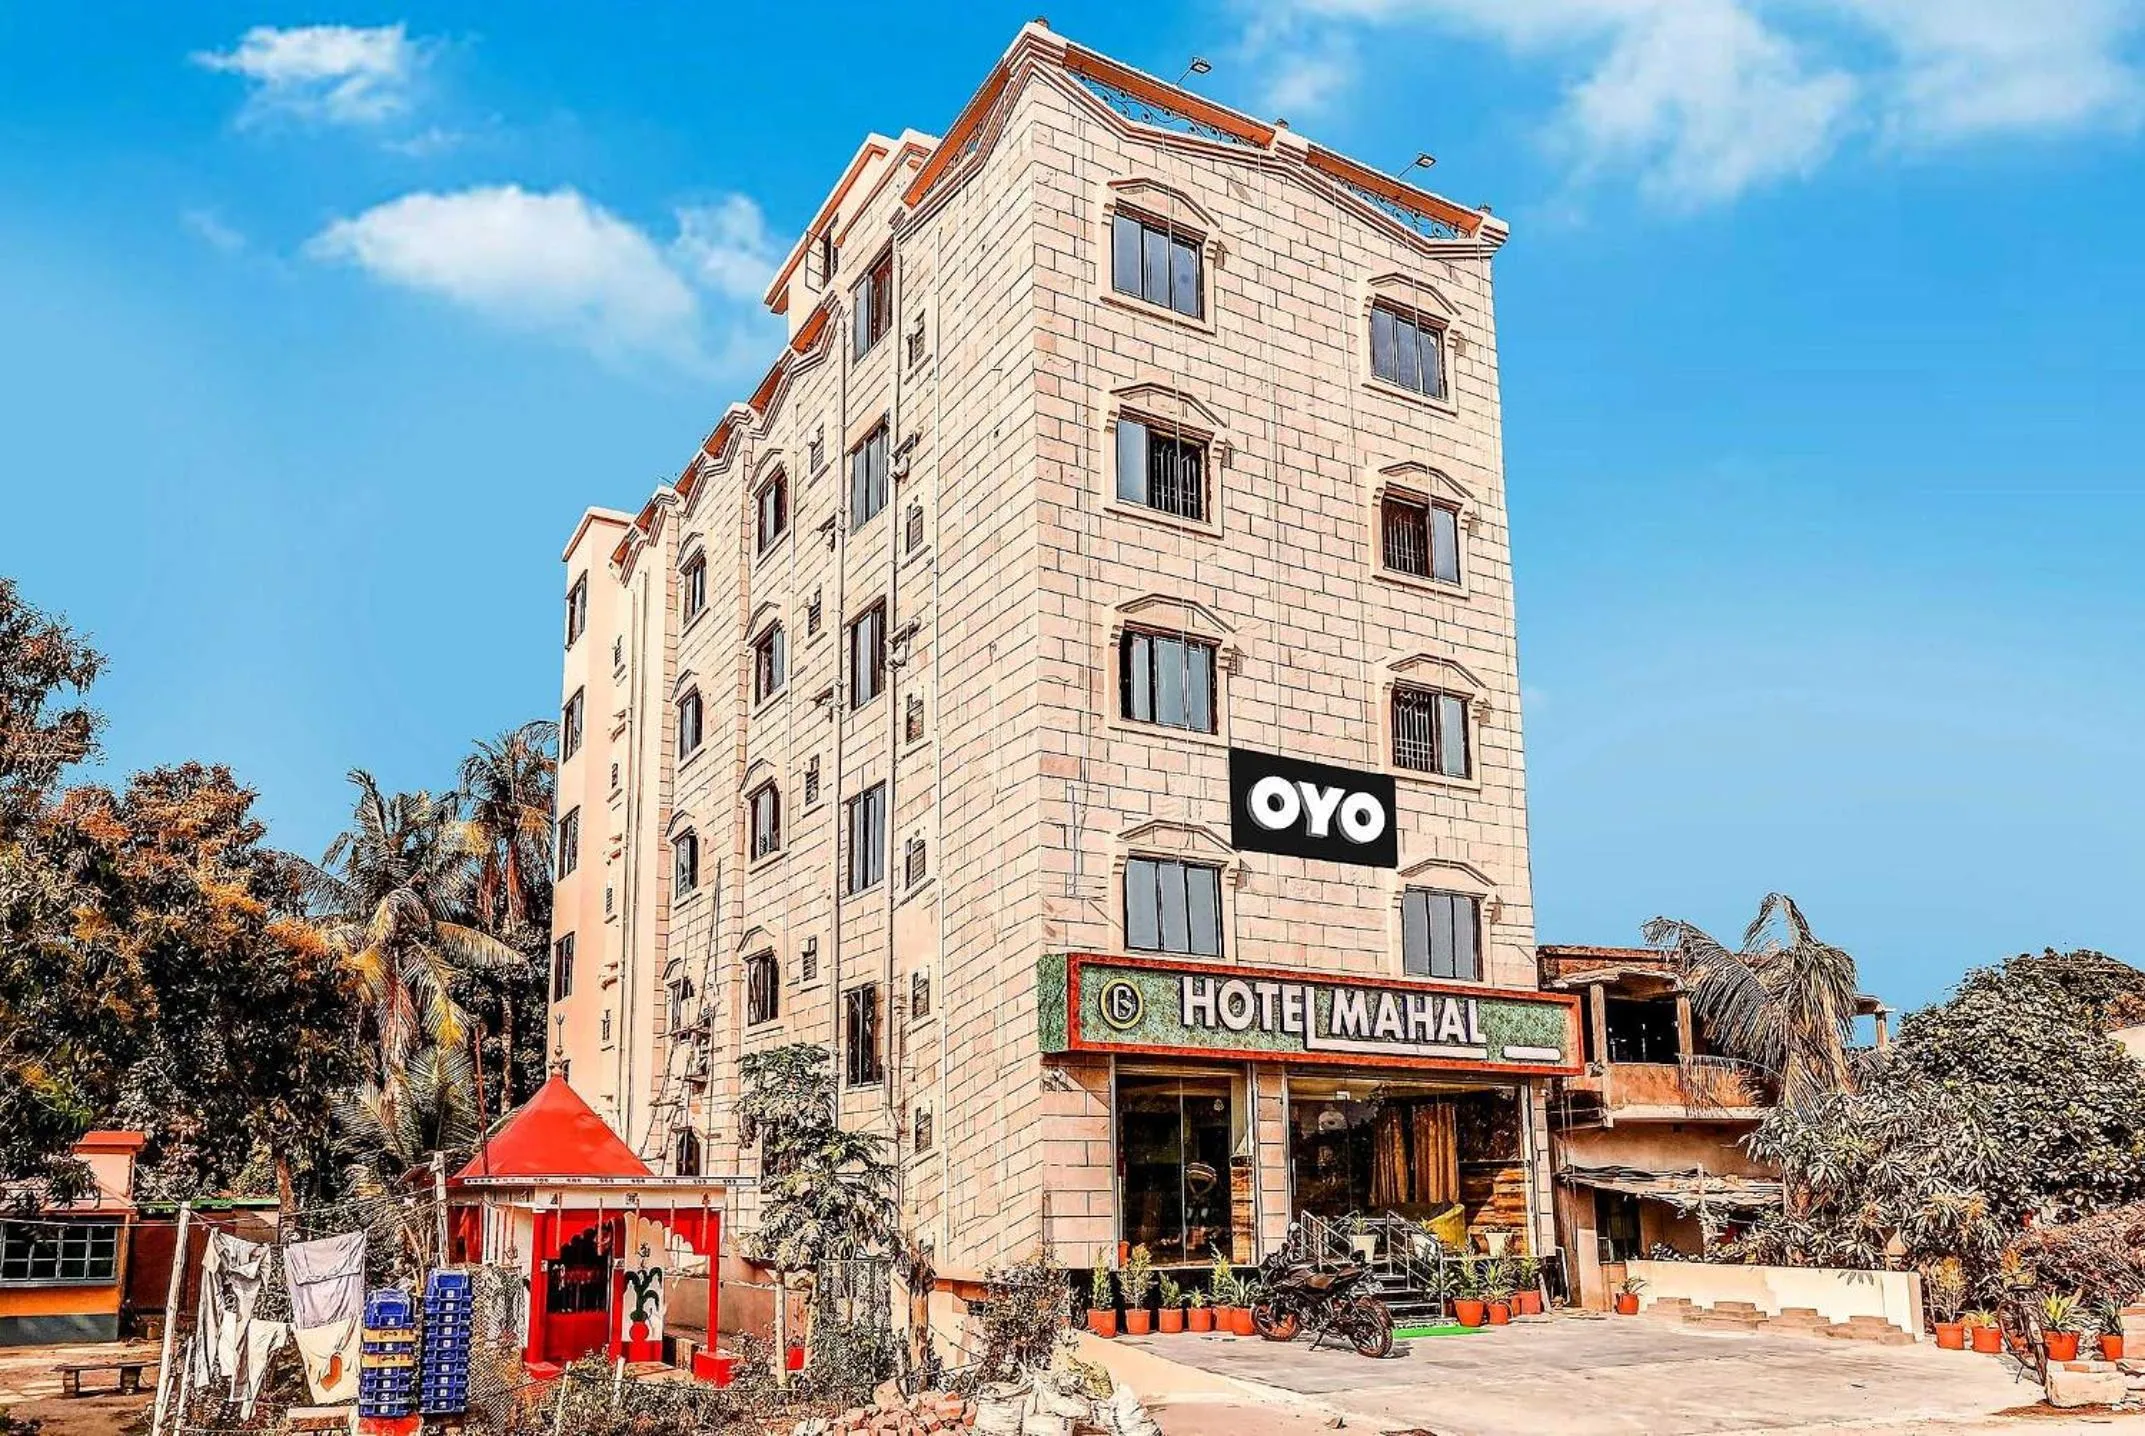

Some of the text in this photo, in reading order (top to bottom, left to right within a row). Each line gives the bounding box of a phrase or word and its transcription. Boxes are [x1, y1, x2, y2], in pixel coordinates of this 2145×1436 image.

[1247, 776, 1385, 844] OYO
[1182, 976, 1487, 1048] HOTEL MAHAL
